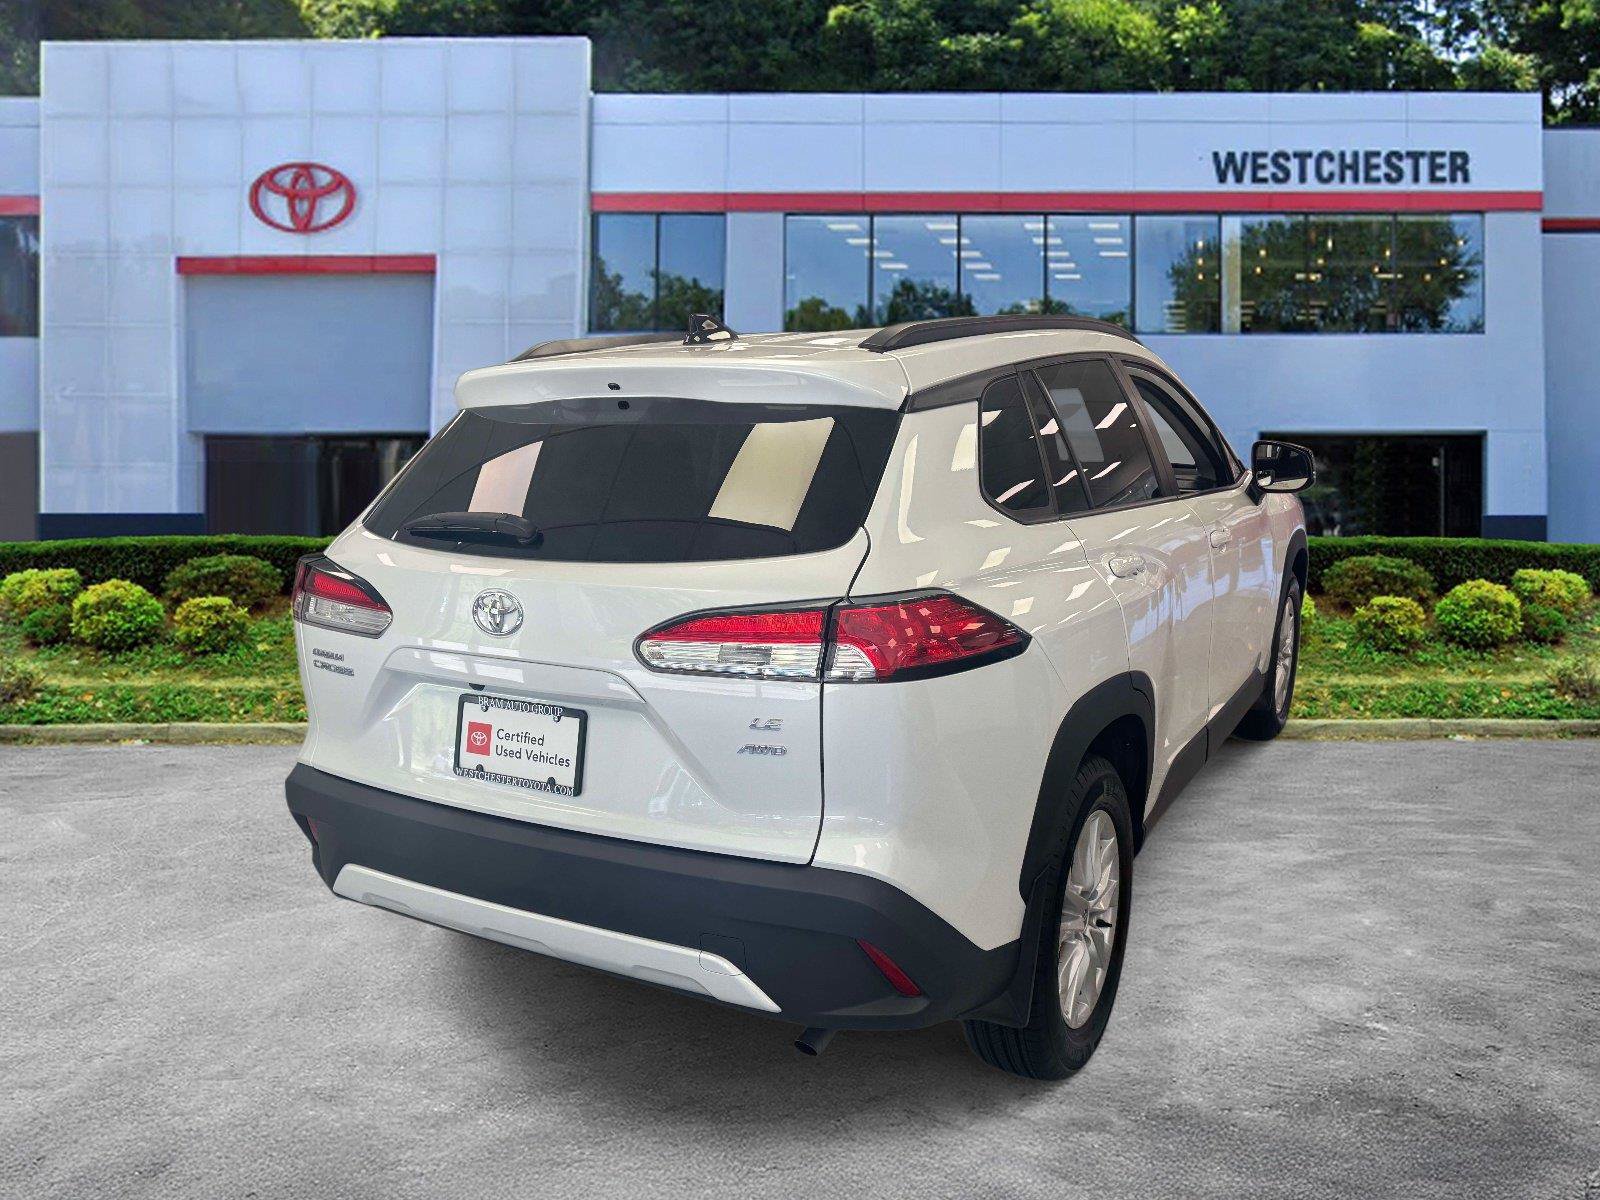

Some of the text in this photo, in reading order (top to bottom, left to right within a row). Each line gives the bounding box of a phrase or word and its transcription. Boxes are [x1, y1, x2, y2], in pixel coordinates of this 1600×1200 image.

[1212, 150, 1470, 184] WESTCHESTER
[478, 696, 563, 717] BRAM AUTO GROUP
[749, 717, 783, 732] LE
[496, 728, 545, 746] Certified
[495, 745, 571, 768] Used Vehicles
[737, 744, 787, 756] AWD
[455, 767, 574, 796] WESTCHESTERTOYOTA.COM
